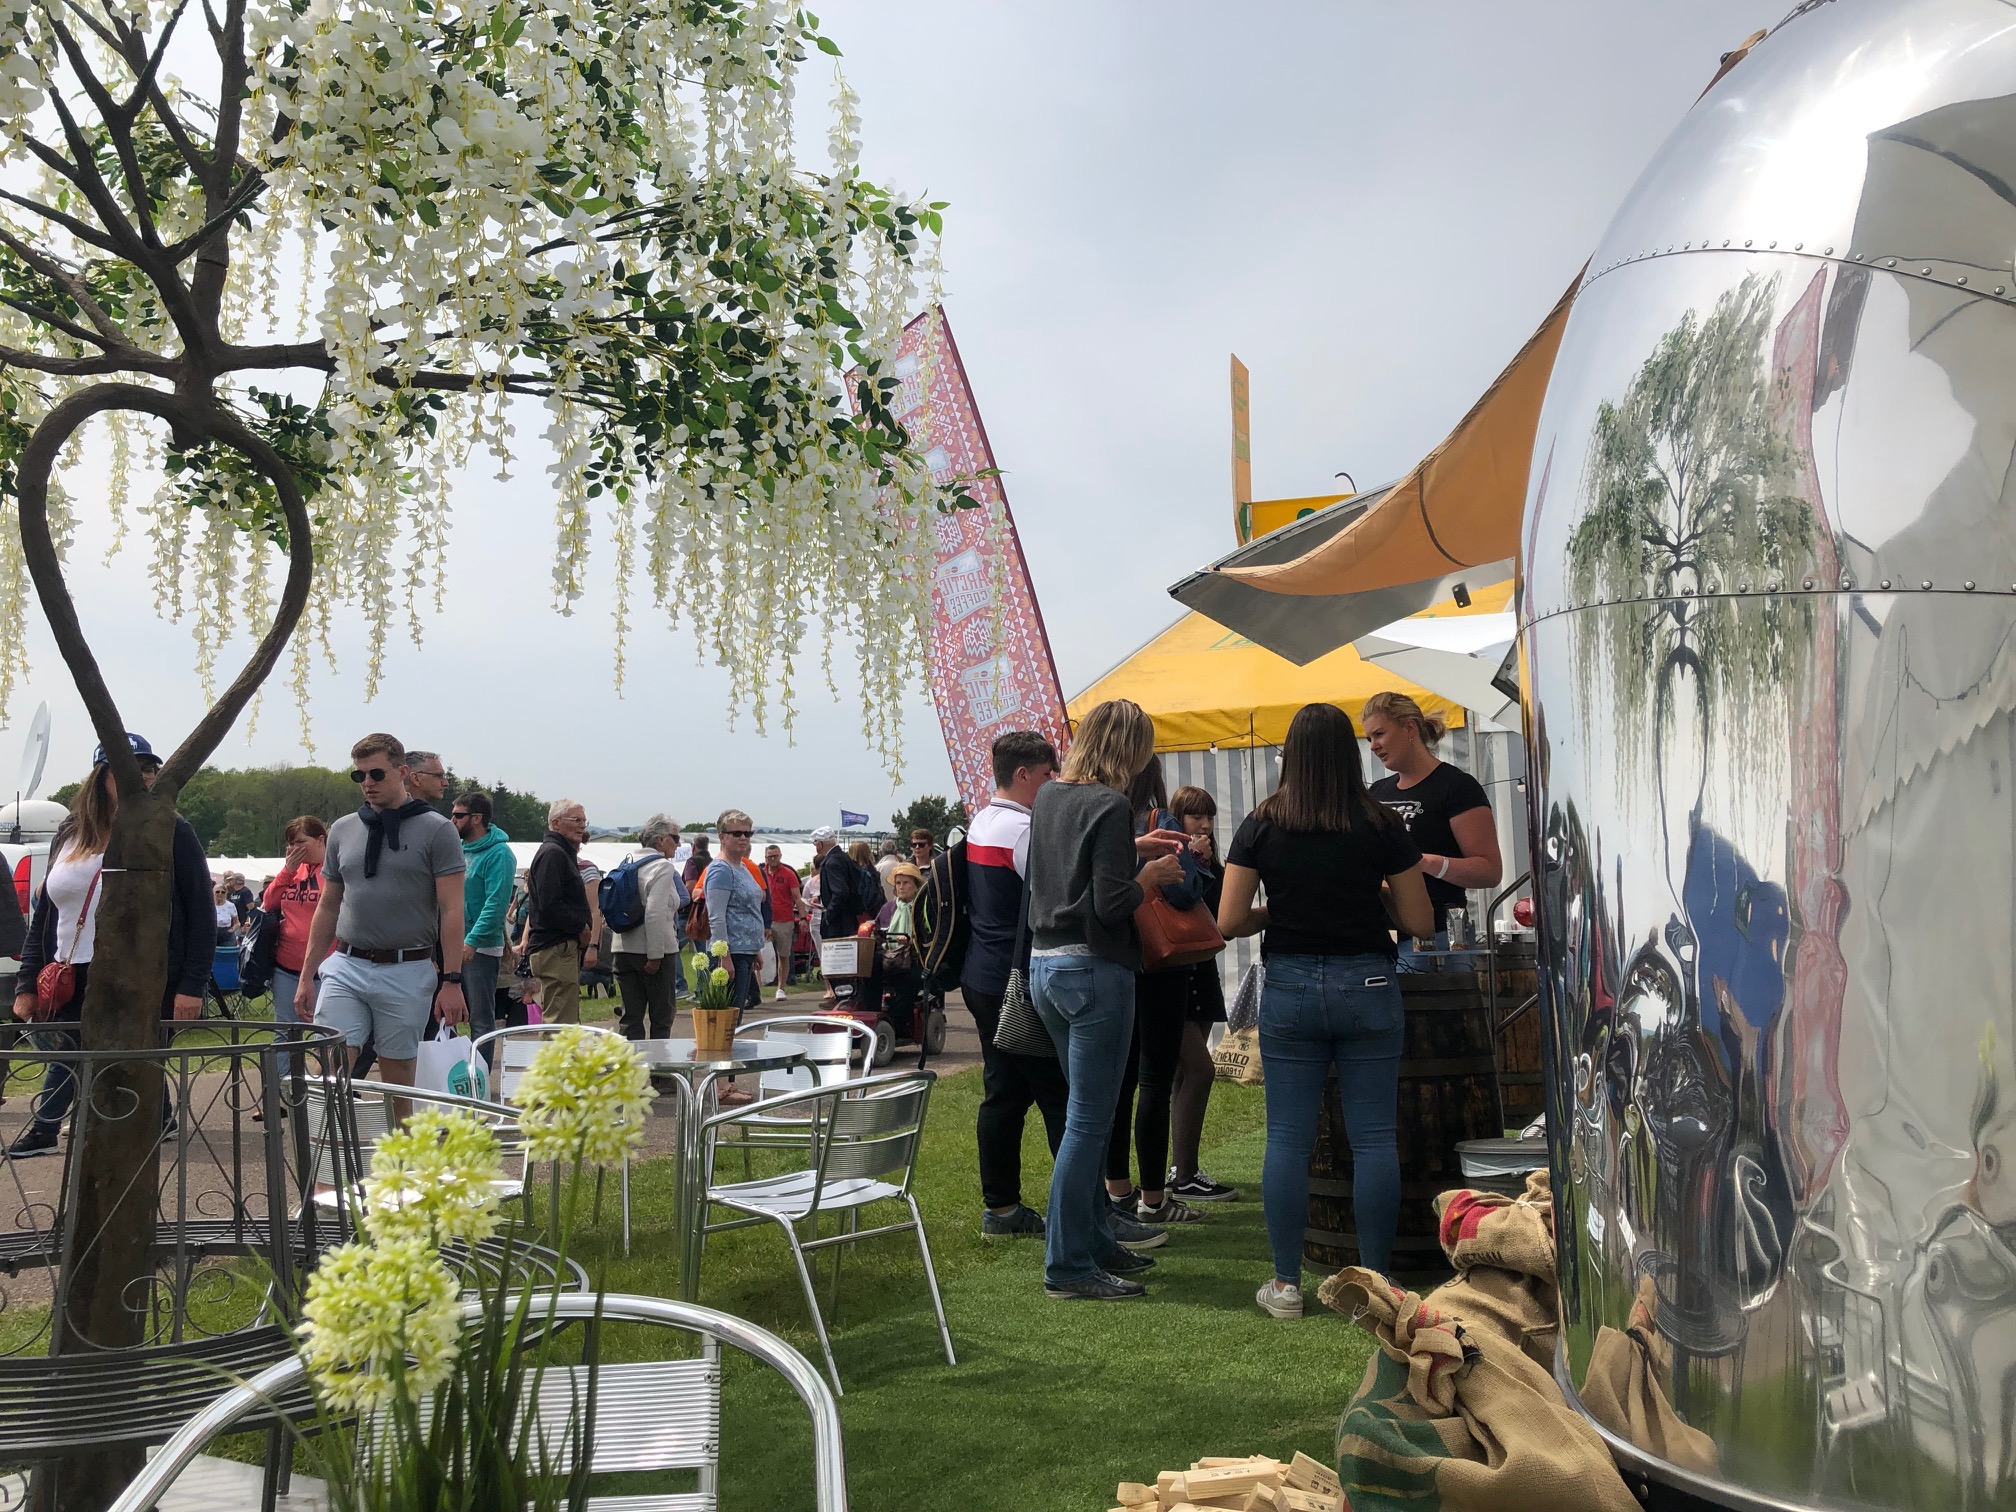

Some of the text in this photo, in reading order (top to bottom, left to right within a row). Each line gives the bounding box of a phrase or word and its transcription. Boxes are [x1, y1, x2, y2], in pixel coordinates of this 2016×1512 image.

[281, 890, 322, 902] adida
[1219, 1050, 1250, 1065] MÉXICO
[1225, 1067, 1242, 1076] 0911
